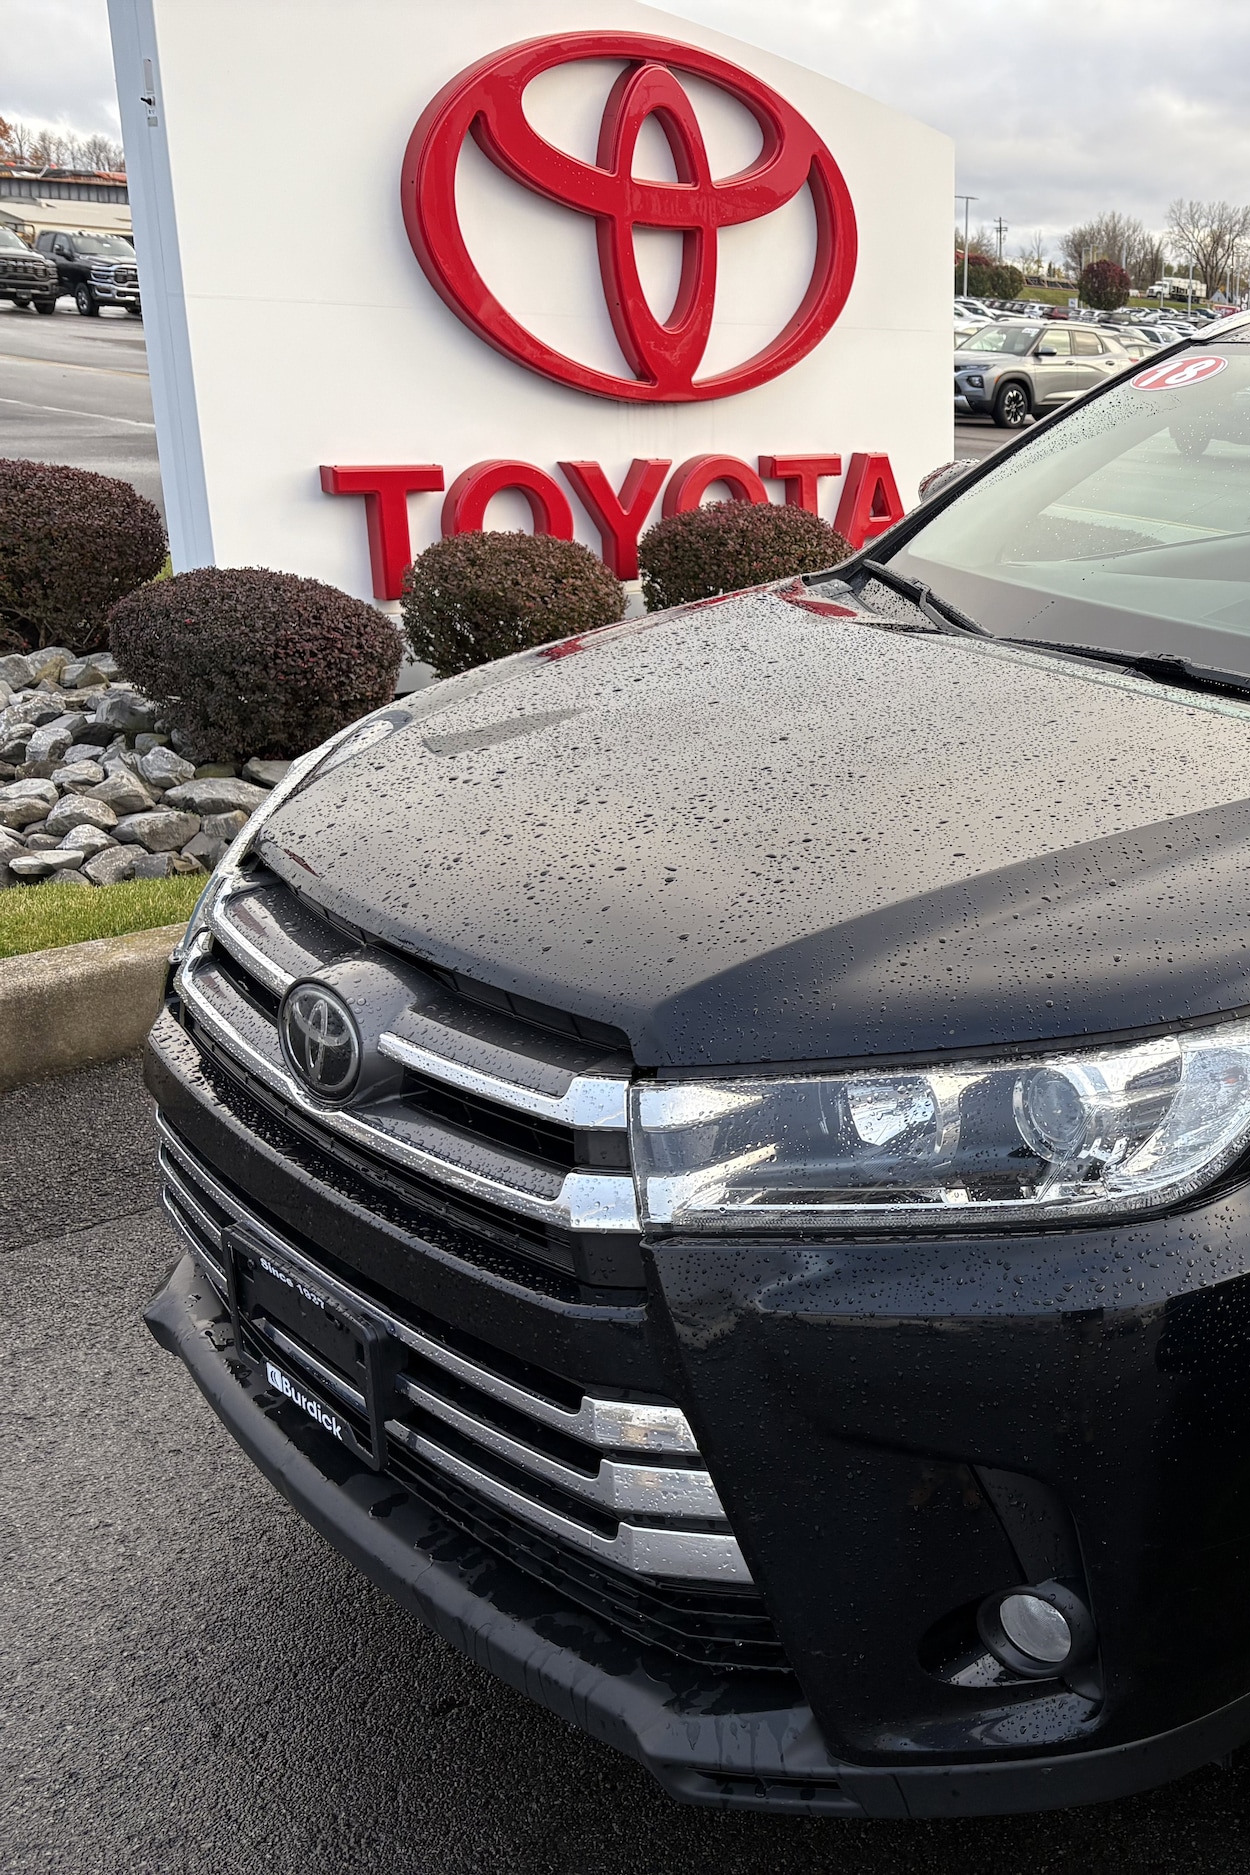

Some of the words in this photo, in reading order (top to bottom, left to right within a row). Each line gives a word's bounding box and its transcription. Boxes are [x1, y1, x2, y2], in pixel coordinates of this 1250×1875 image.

[1138, 358, 1218, 388] 18
[319, 452, 907, 601] TOYOTA
[260, 1257, 294, 1288] Since
[281, 1375, 343, 1441] Burdick
